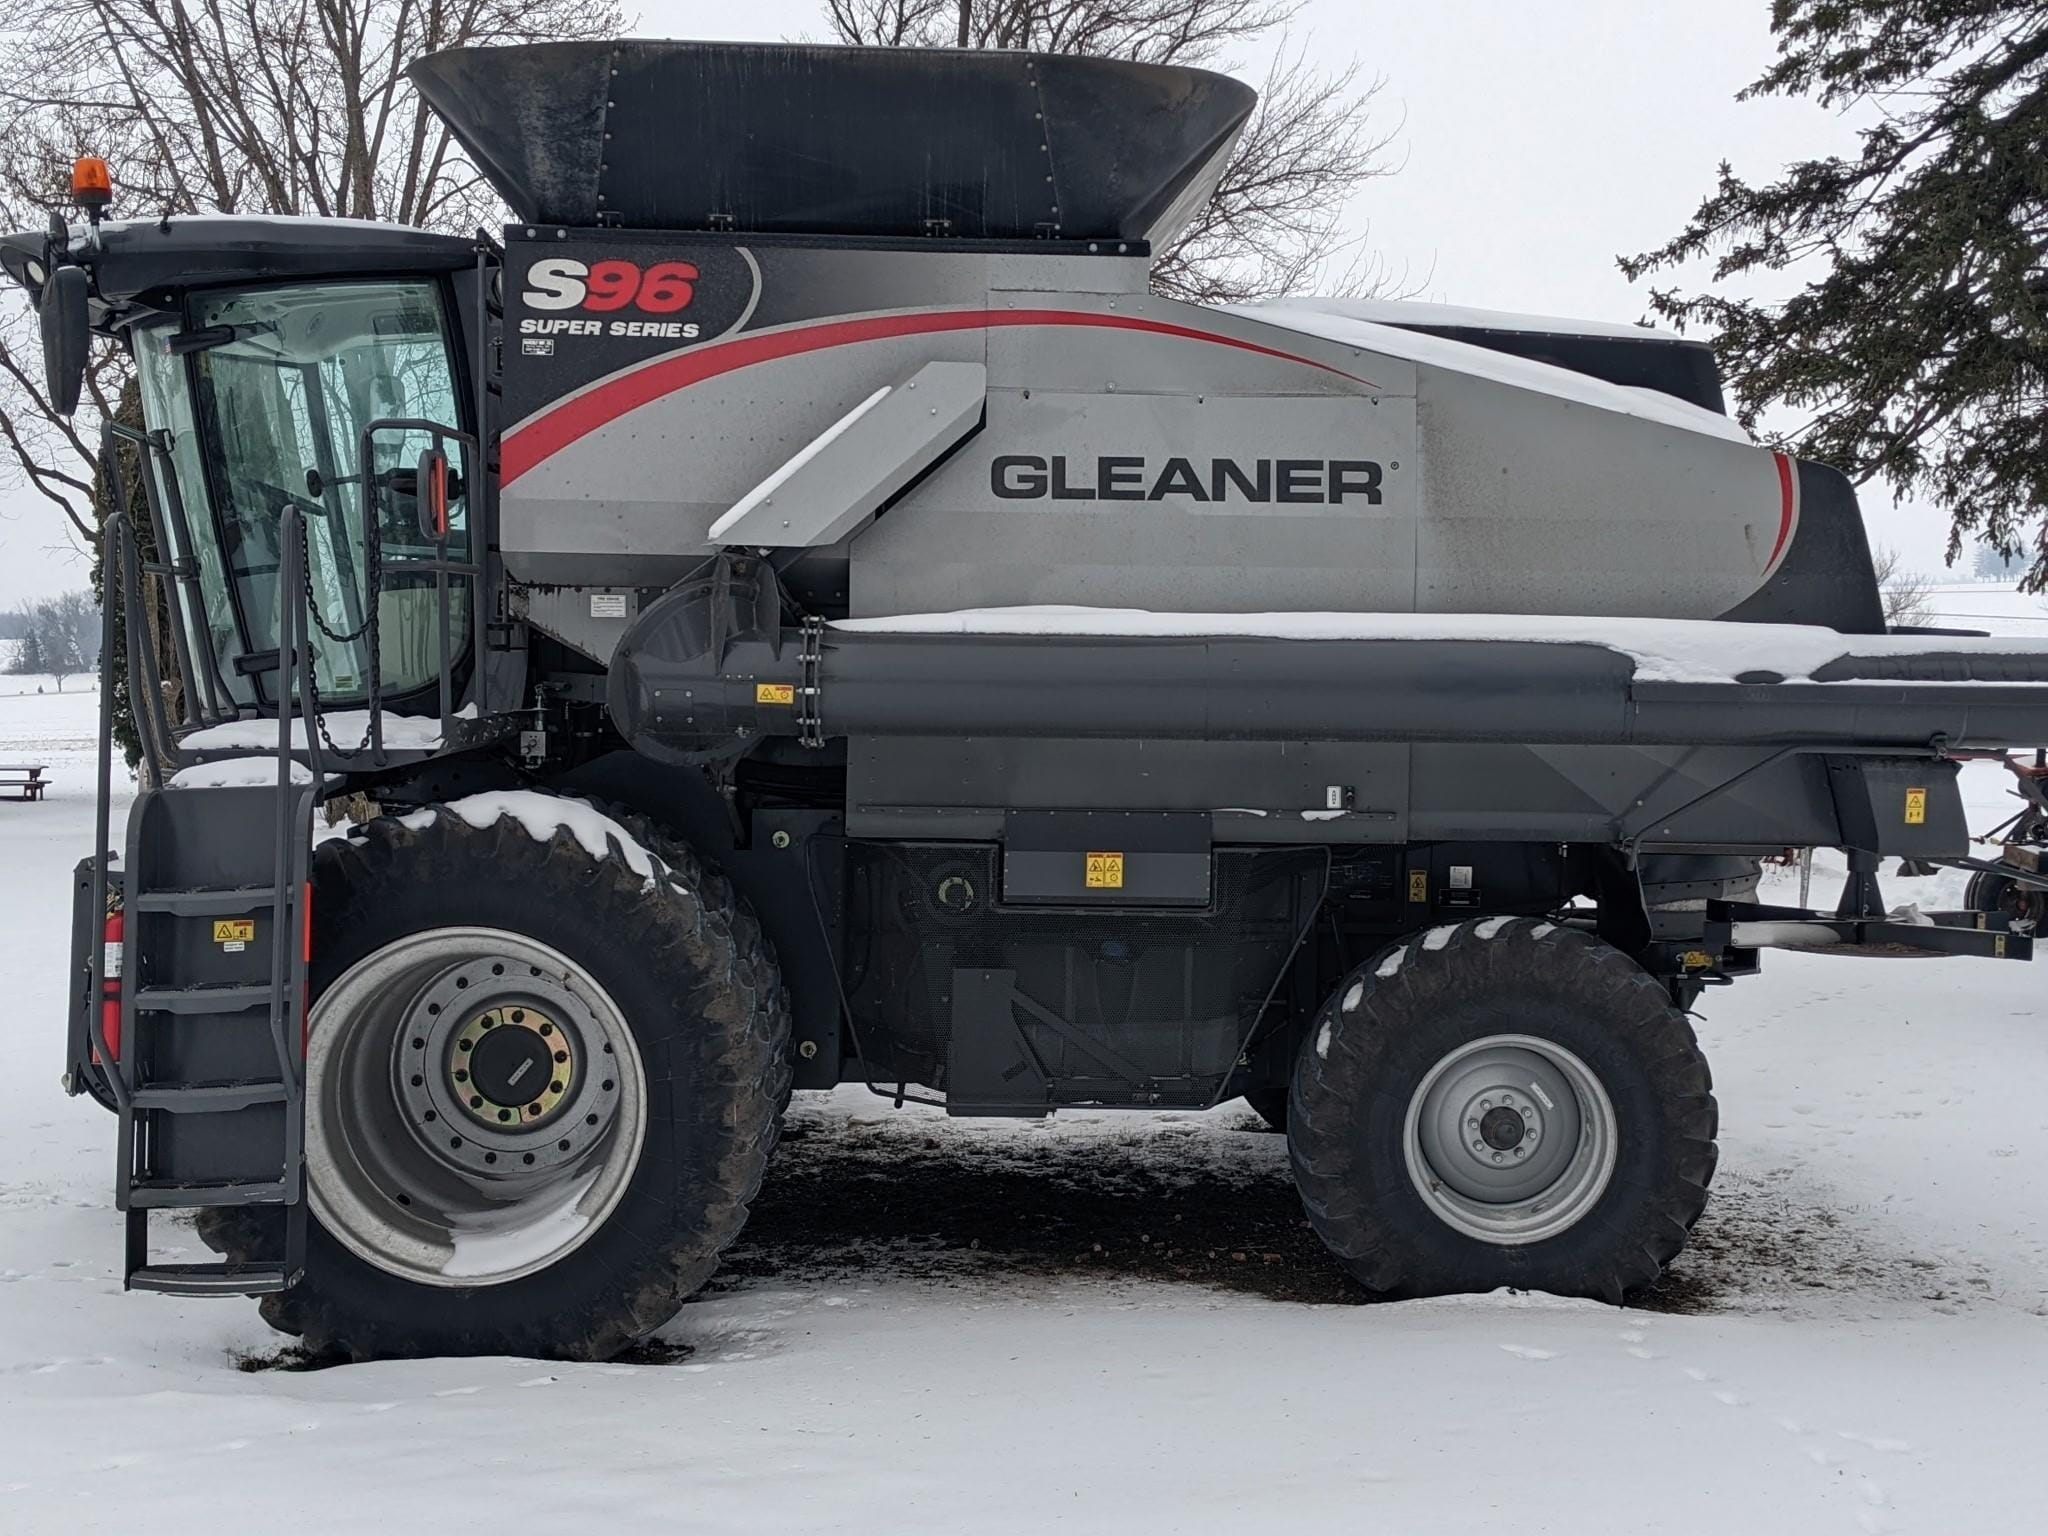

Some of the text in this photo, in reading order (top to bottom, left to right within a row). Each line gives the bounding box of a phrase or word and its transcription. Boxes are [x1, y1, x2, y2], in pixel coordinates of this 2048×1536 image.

[522, 258, 699, 313] S96
[519, 319, 700, 338] SUPER SERIES
[990, 455, 1383, 505] GLEANER
